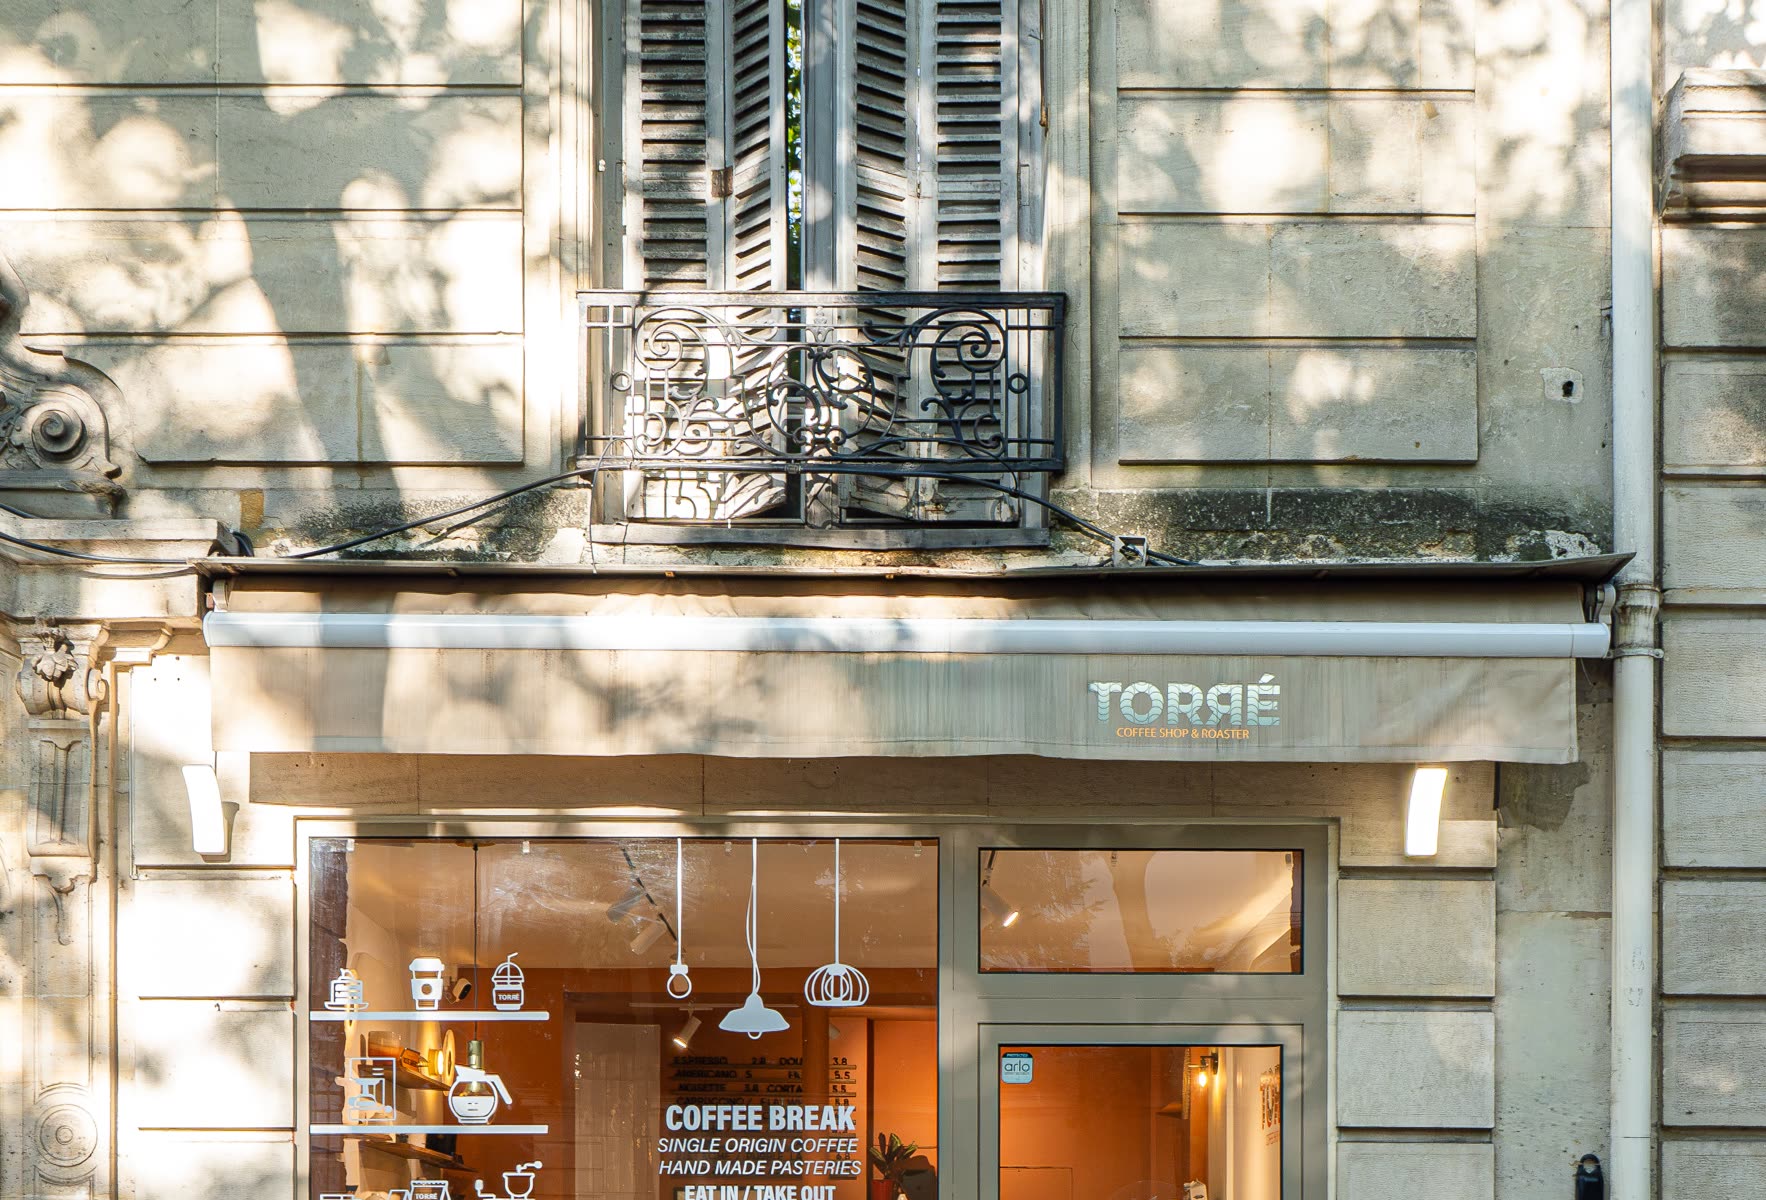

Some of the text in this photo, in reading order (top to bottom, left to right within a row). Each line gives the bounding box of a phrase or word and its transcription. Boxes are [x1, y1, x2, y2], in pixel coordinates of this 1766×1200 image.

[1116, 728, 1249, 739] COFFEE SHOP & ROASTER
[833, 1057, 848, 1065] 3.8
[1004, 1060, 1030, 1072] arlo
[834, 1070, 850, 1079] 5.5
[832, 1085, 847, 1093] 5.5
[666, 1105, 856, 1131] COFFEE BREAK
[658, 1138, 859, 1153] SINGLE ORIGIN COFFEE
[658, 1160, 861, 1175] HAND MADE PASTERIES
